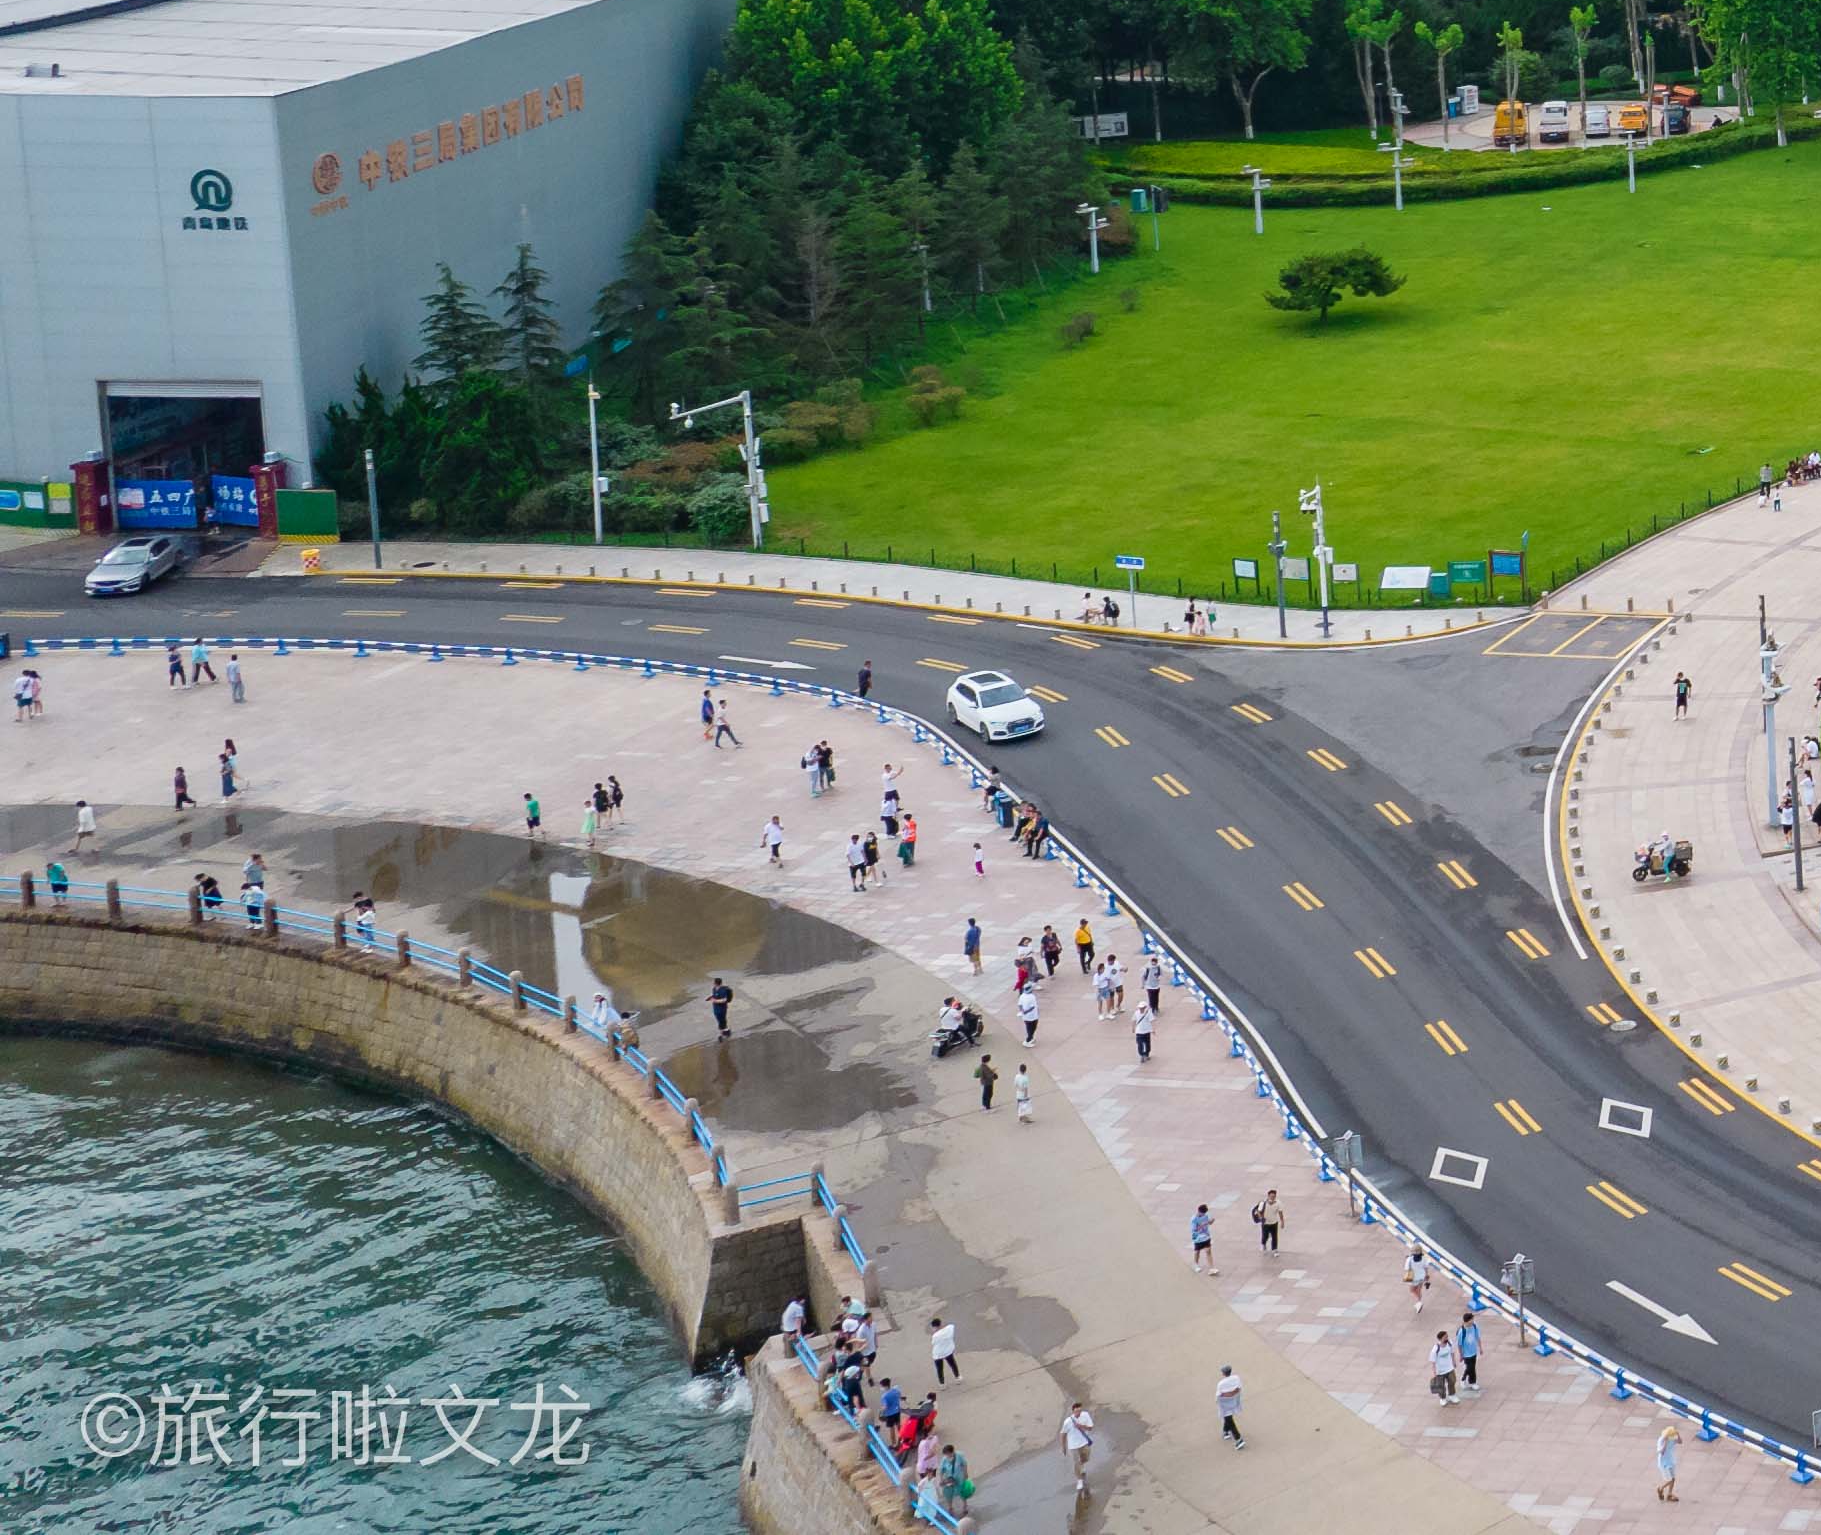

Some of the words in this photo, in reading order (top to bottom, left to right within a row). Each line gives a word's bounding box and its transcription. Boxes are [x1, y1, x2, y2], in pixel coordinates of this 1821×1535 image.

[359, 74, 585, 190] 中铁三局集团有限公司
[182, 216, 249, 231] 青岛地铁
